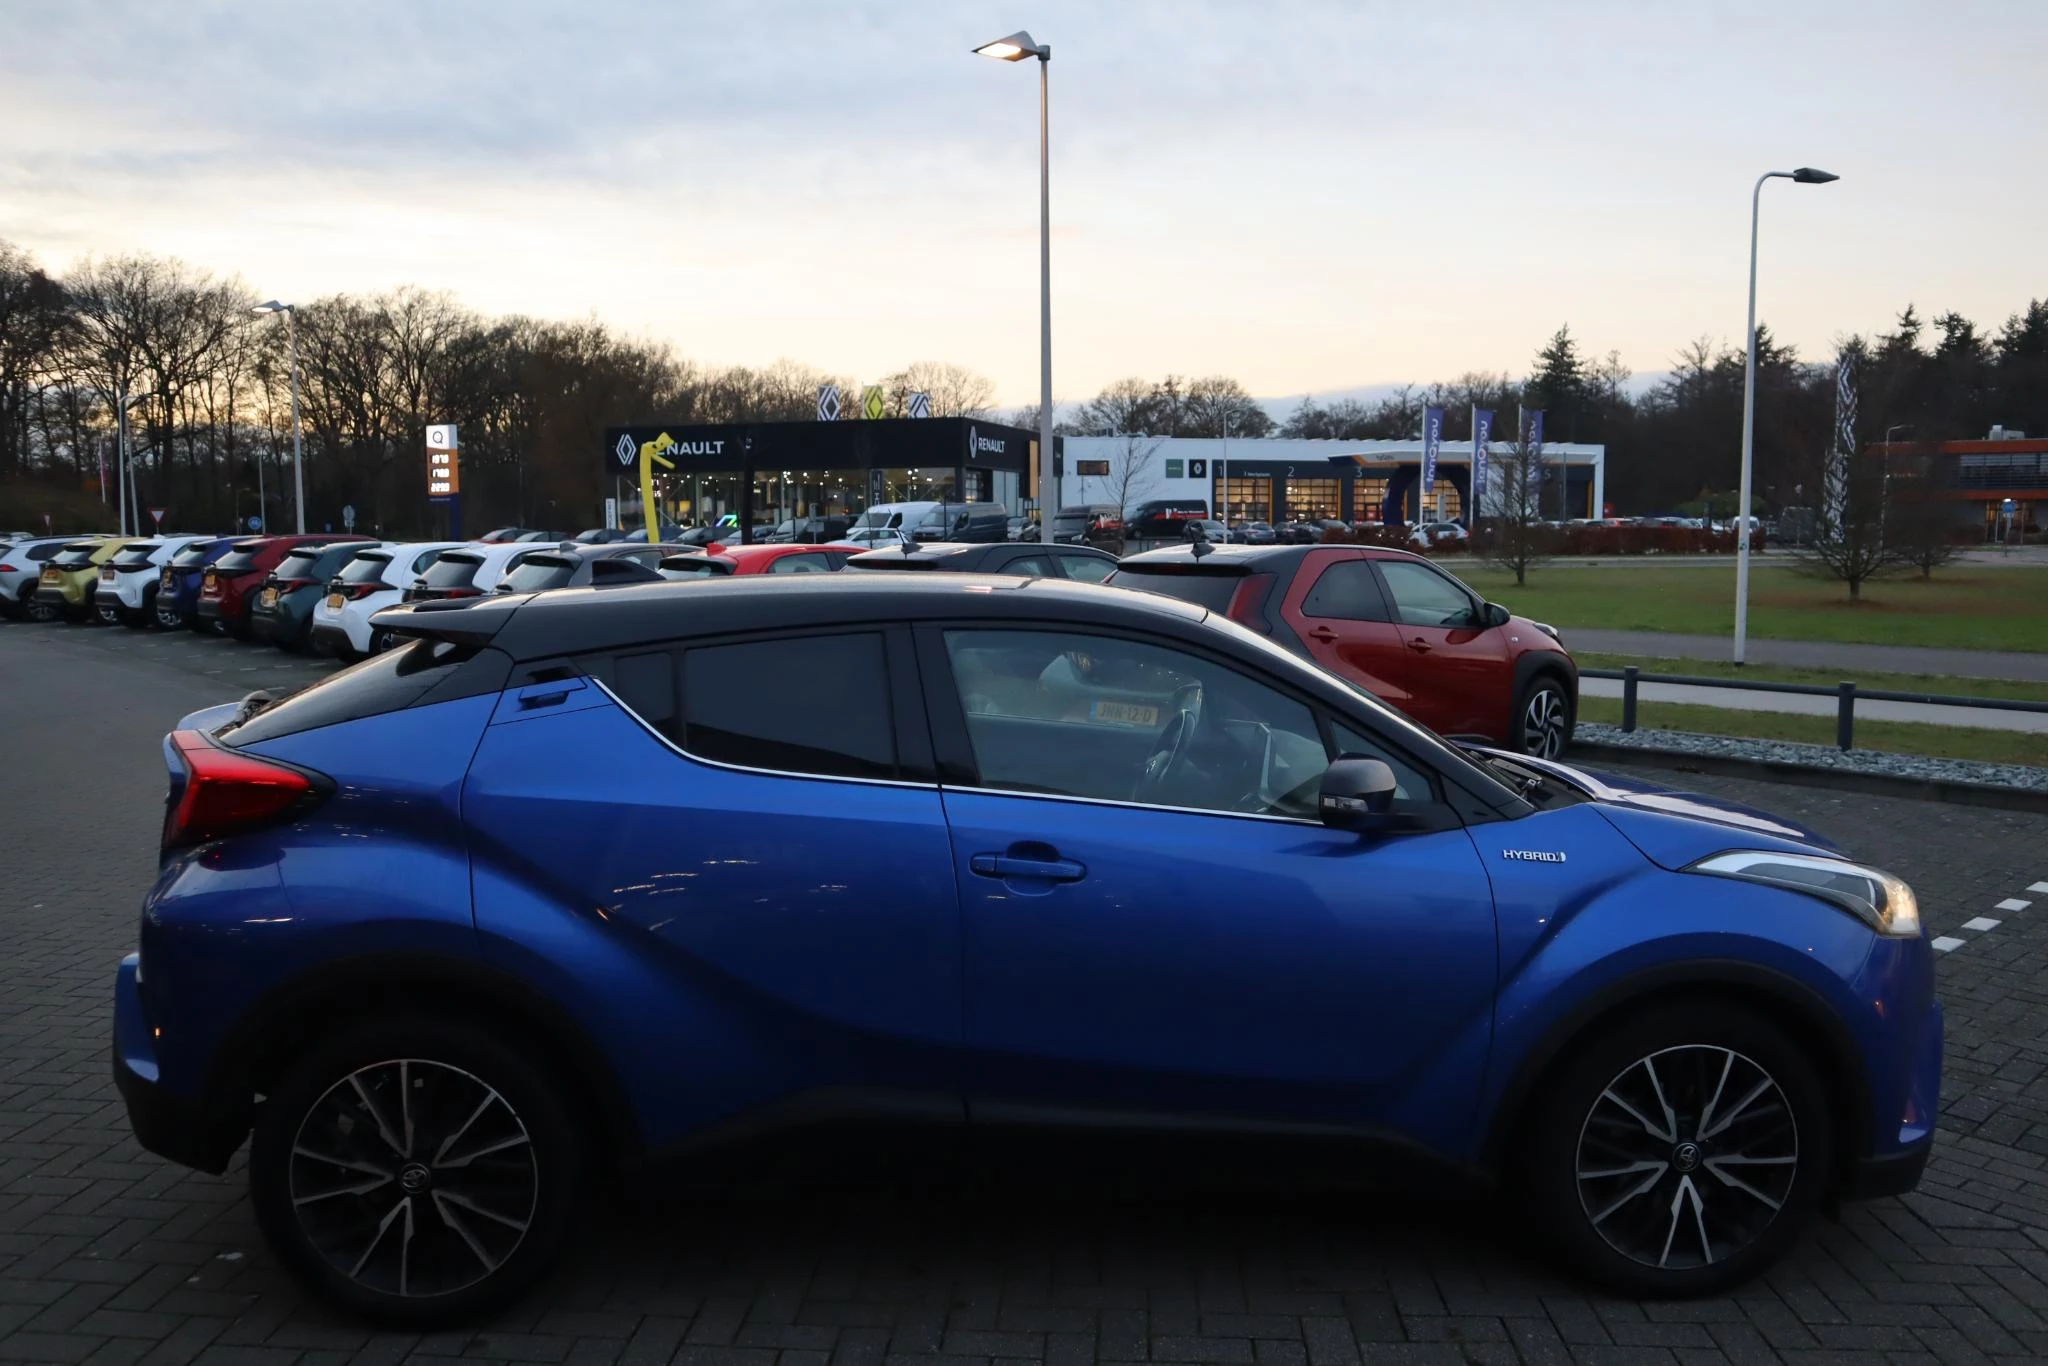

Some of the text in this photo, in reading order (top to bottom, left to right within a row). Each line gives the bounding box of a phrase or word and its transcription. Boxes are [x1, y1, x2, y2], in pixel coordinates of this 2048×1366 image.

[432, 431, 444, 445] Q
[978, 437, 1005, 453] RENAULT
[656, 441, 725, 456] NAULT
[1287, 466, 1295, 477] 2
[1503, 849, 1557, 862] HYBRID
